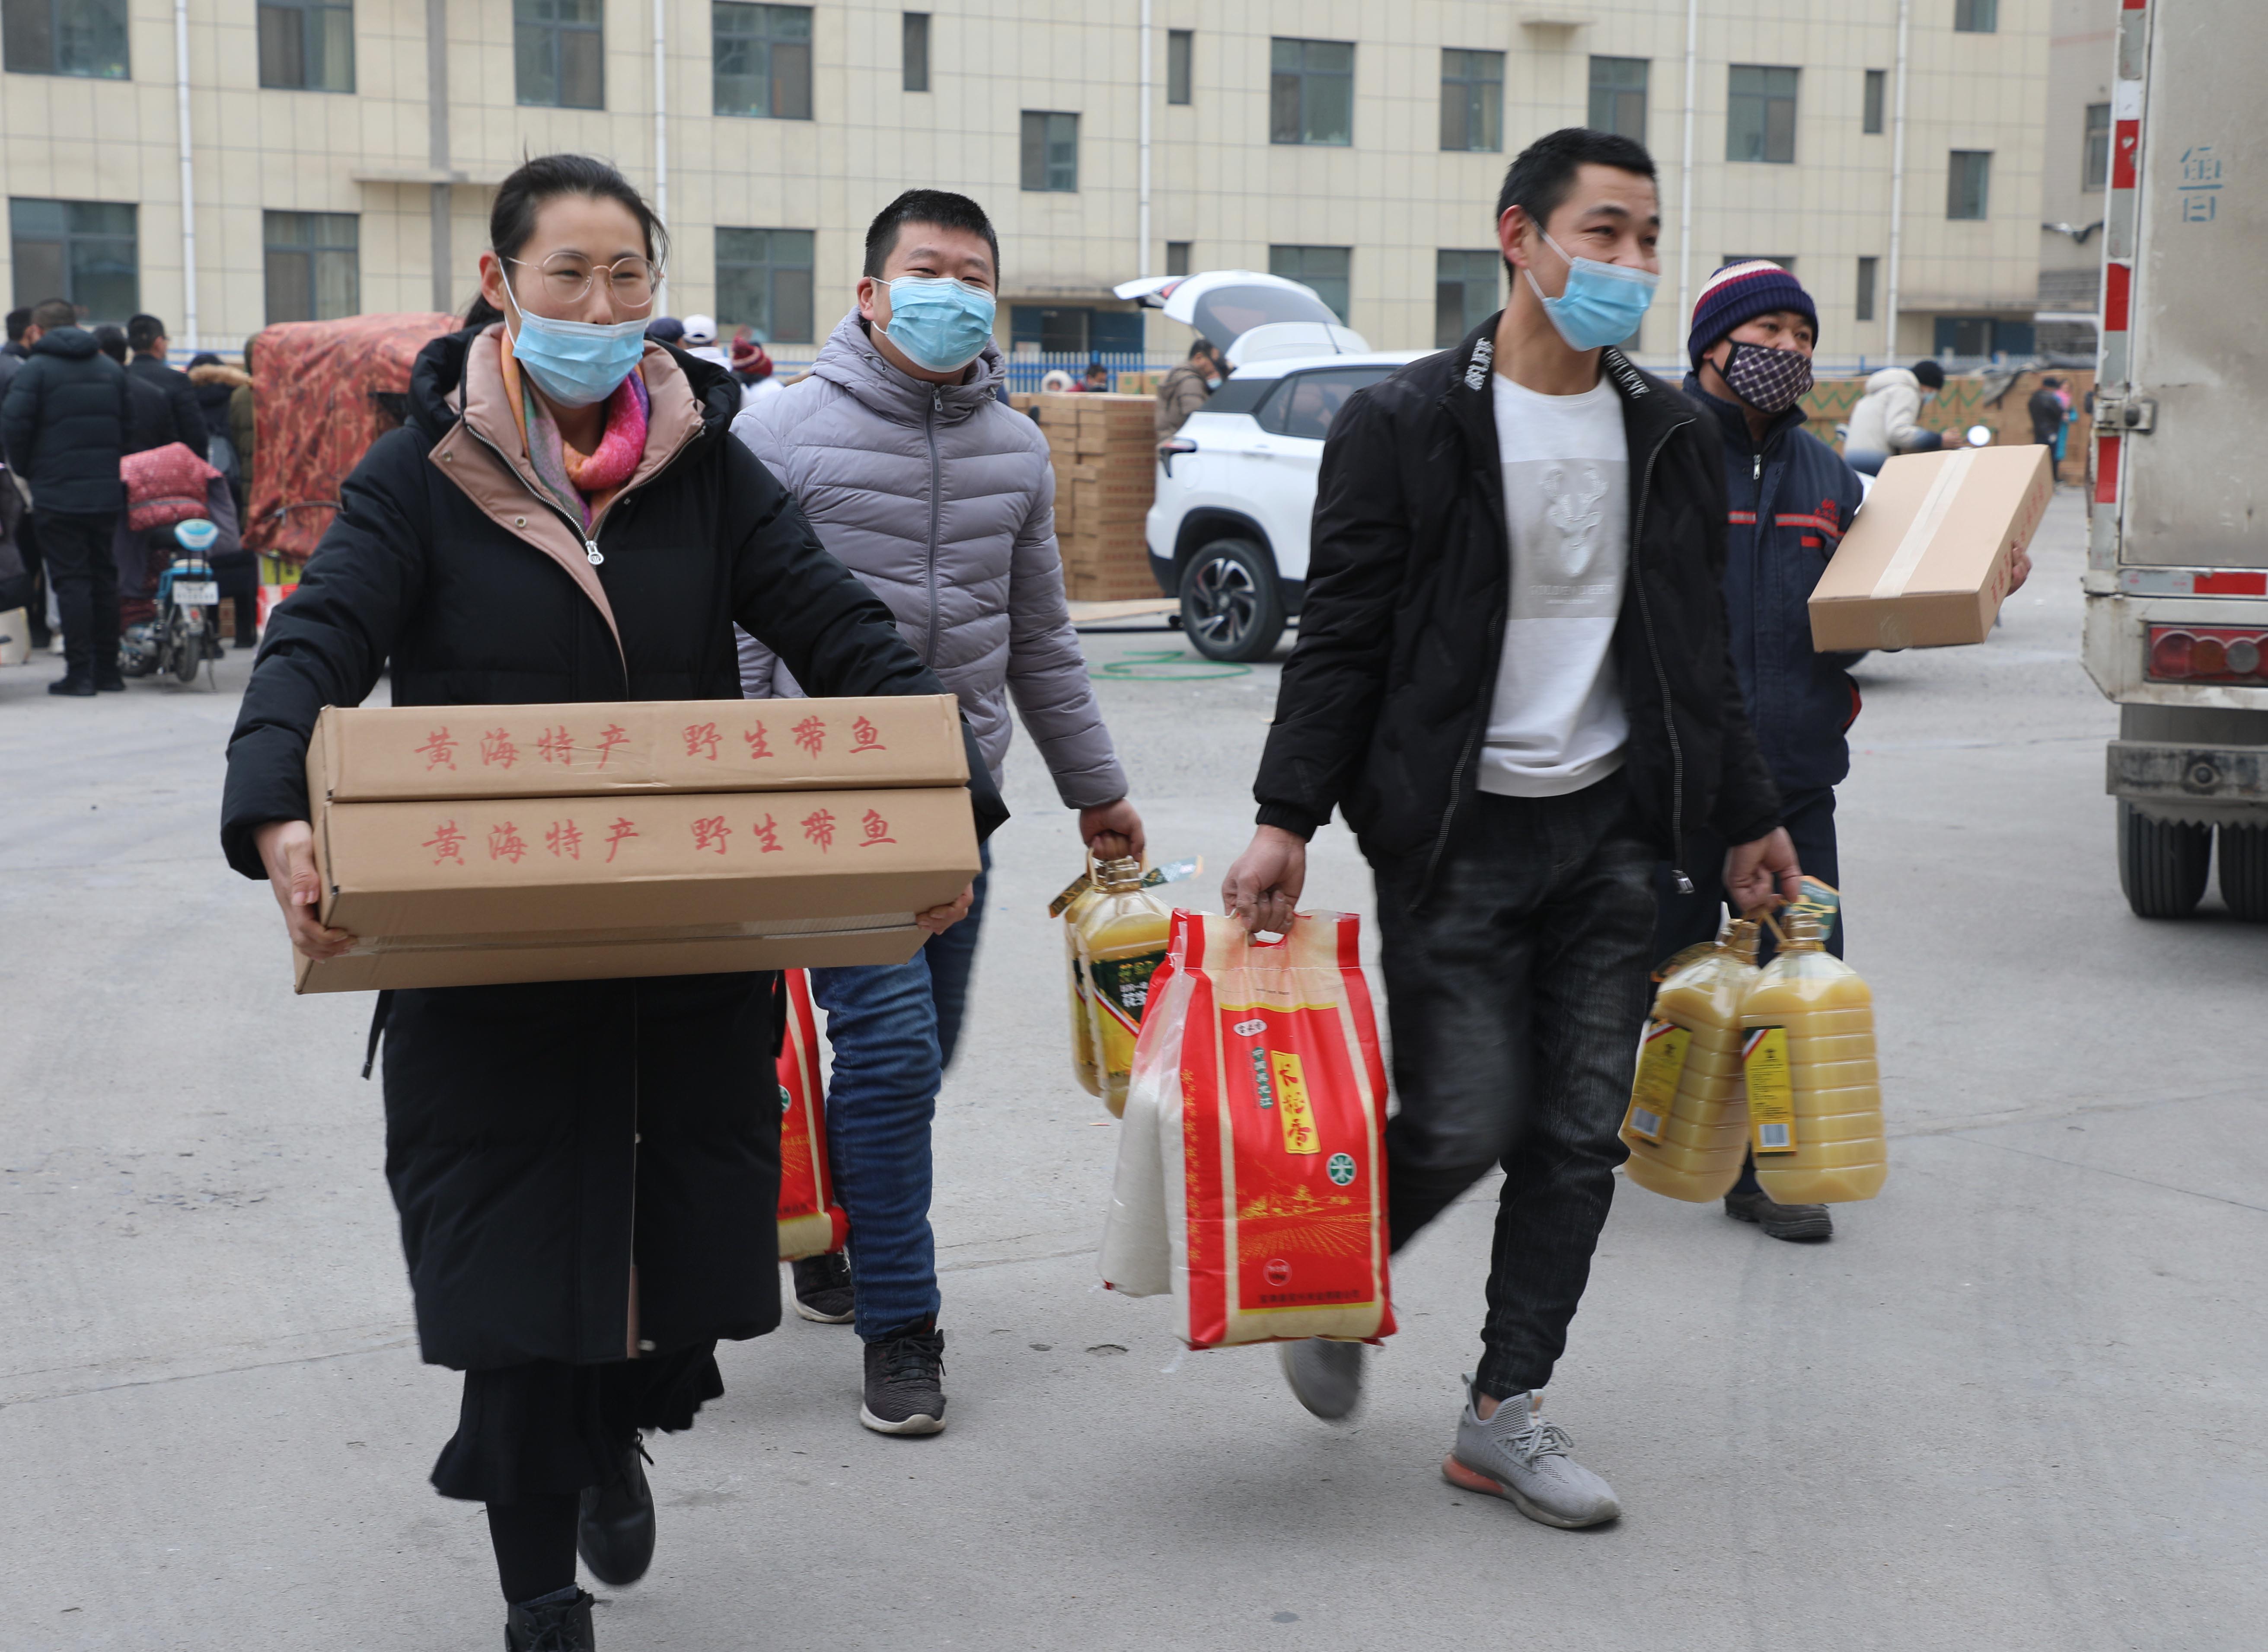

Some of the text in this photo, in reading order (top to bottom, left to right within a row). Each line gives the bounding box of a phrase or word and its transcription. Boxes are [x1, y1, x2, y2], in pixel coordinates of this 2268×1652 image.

[414, 715, 887, 773] 黄海特产 野生带鱼
[421, 808, 898, 866] 黄海特产 野生带鱼
